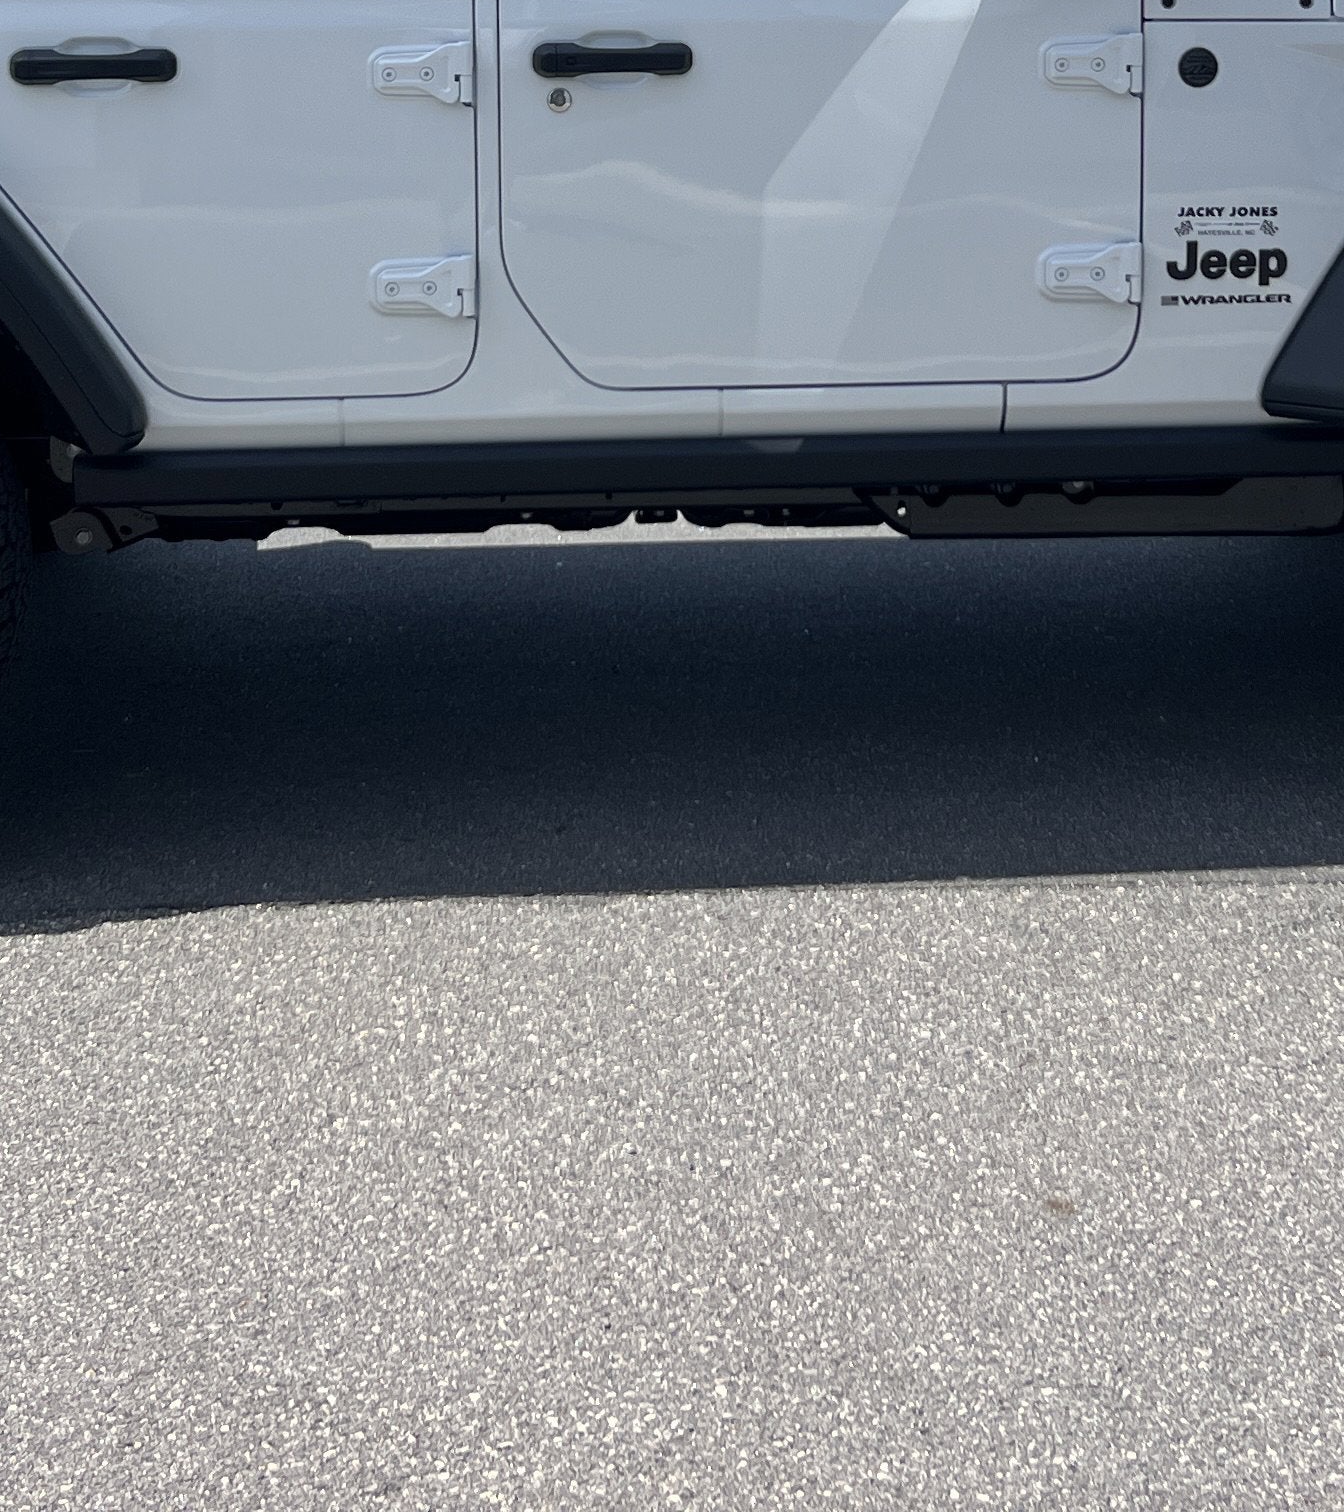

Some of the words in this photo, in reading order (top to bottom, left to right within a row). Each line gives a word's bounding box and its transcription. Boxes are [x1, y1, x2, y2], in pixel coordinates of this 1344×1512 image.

[1177, 206, 1225, 217] JACKY
[1229, 206, 1278, 217] JONES
[1166, 240, 1288, 286] Jeep
[1181, 293, 1292, 305] WRANGLER
